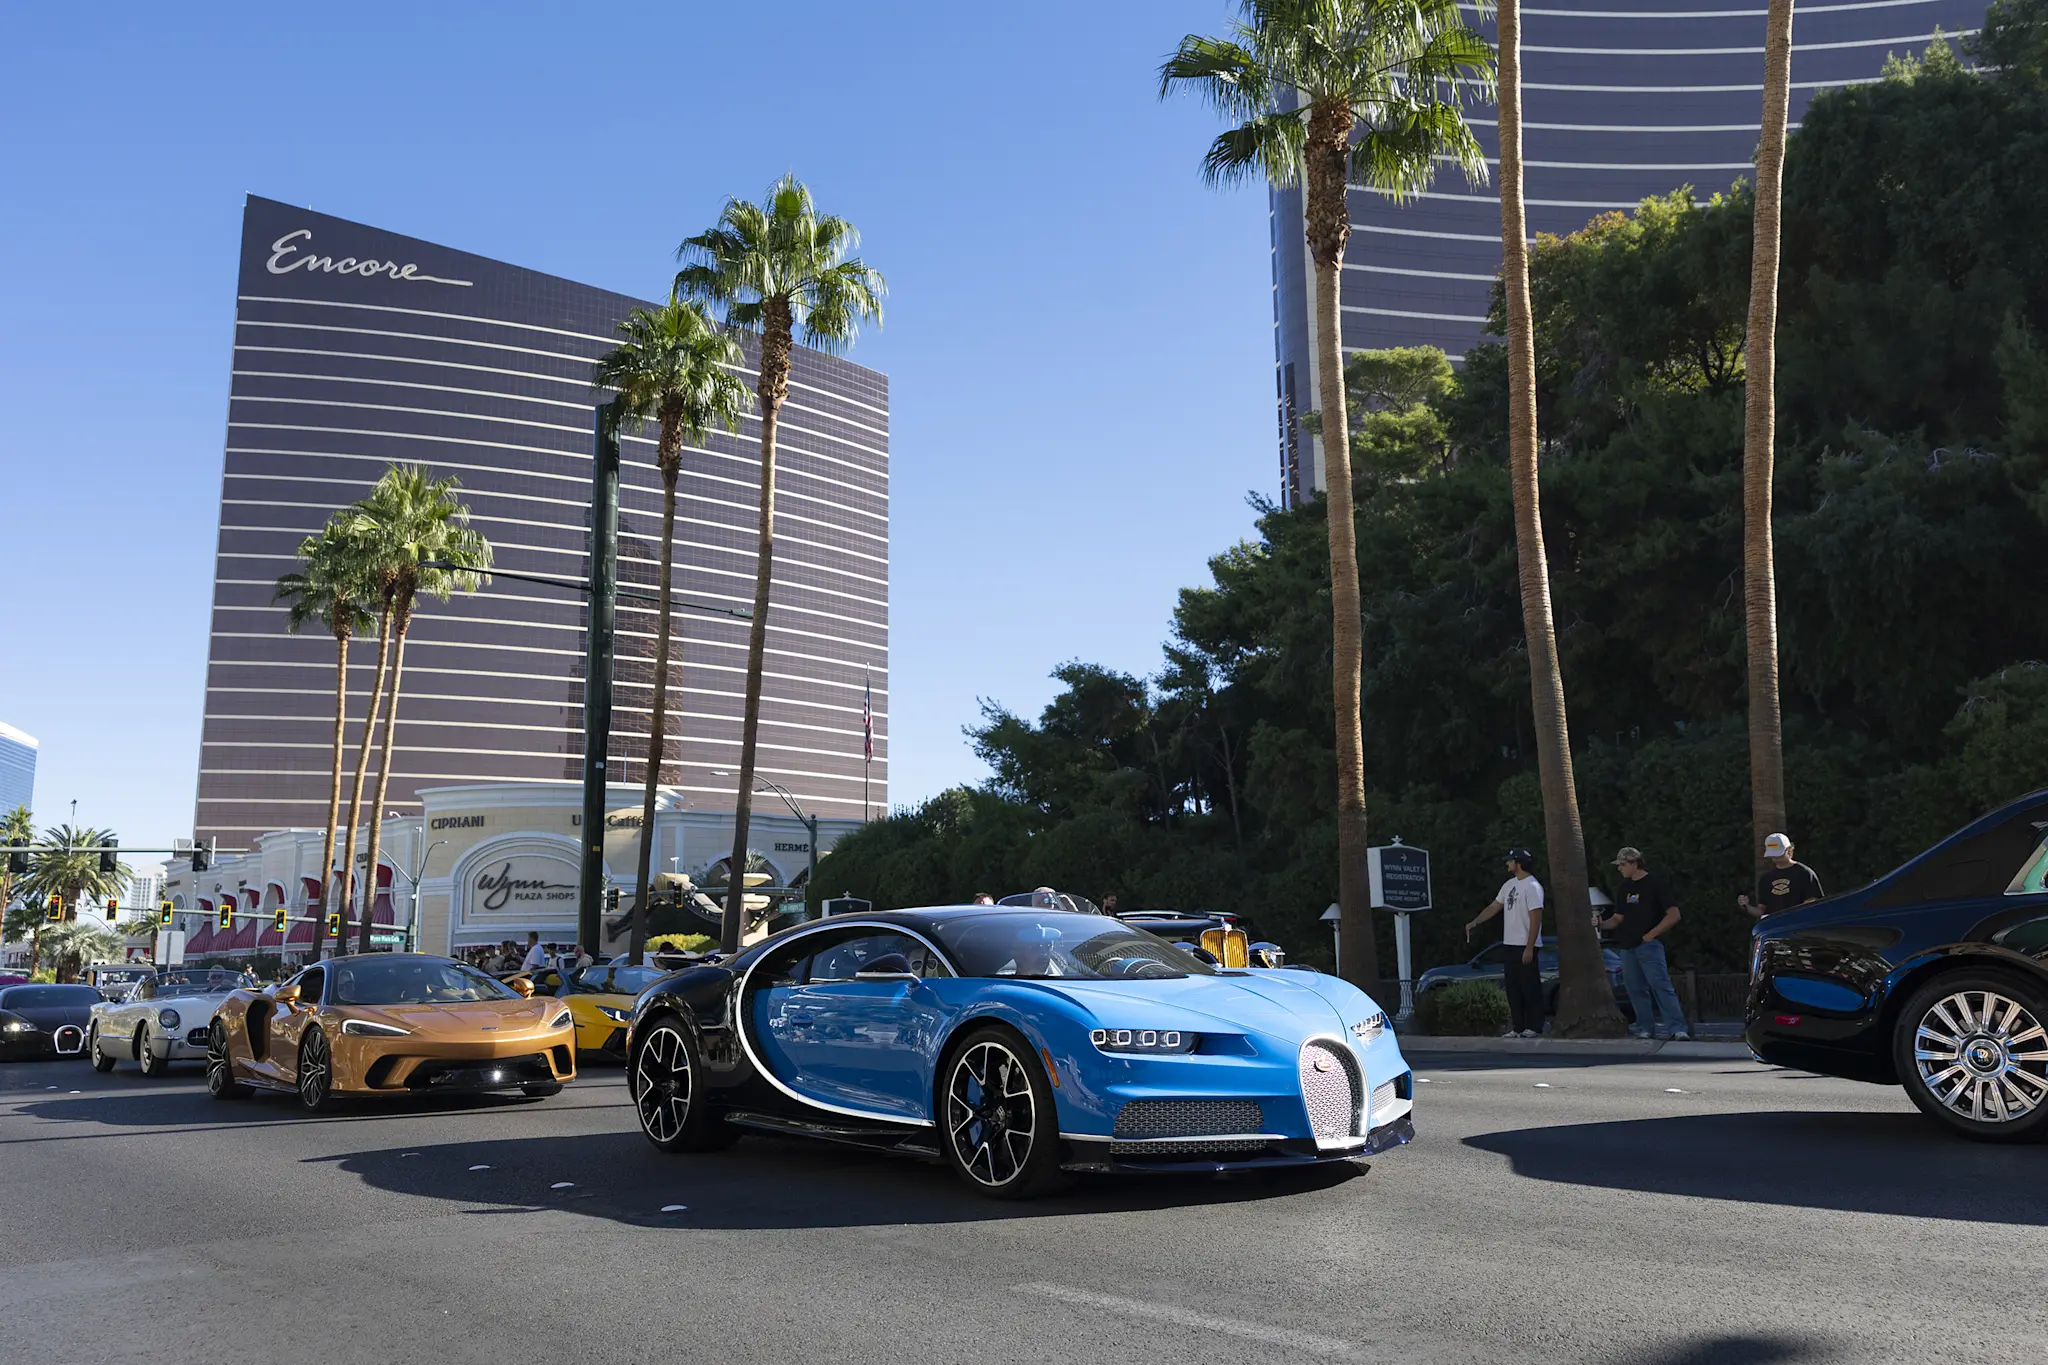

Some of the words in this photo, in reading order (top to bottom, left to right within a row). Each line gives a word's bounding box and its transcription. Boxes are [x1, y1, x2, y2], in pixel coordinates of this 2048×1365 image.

[266, 229, 473, 287] Encore
[431, 816, 485, 830] CIPRIANI
[1386, 873, 1425, 881] REGISTRATION
[514, 893, 543, 901] PLAZA
[546, 892, 575, 900] SHOPS
